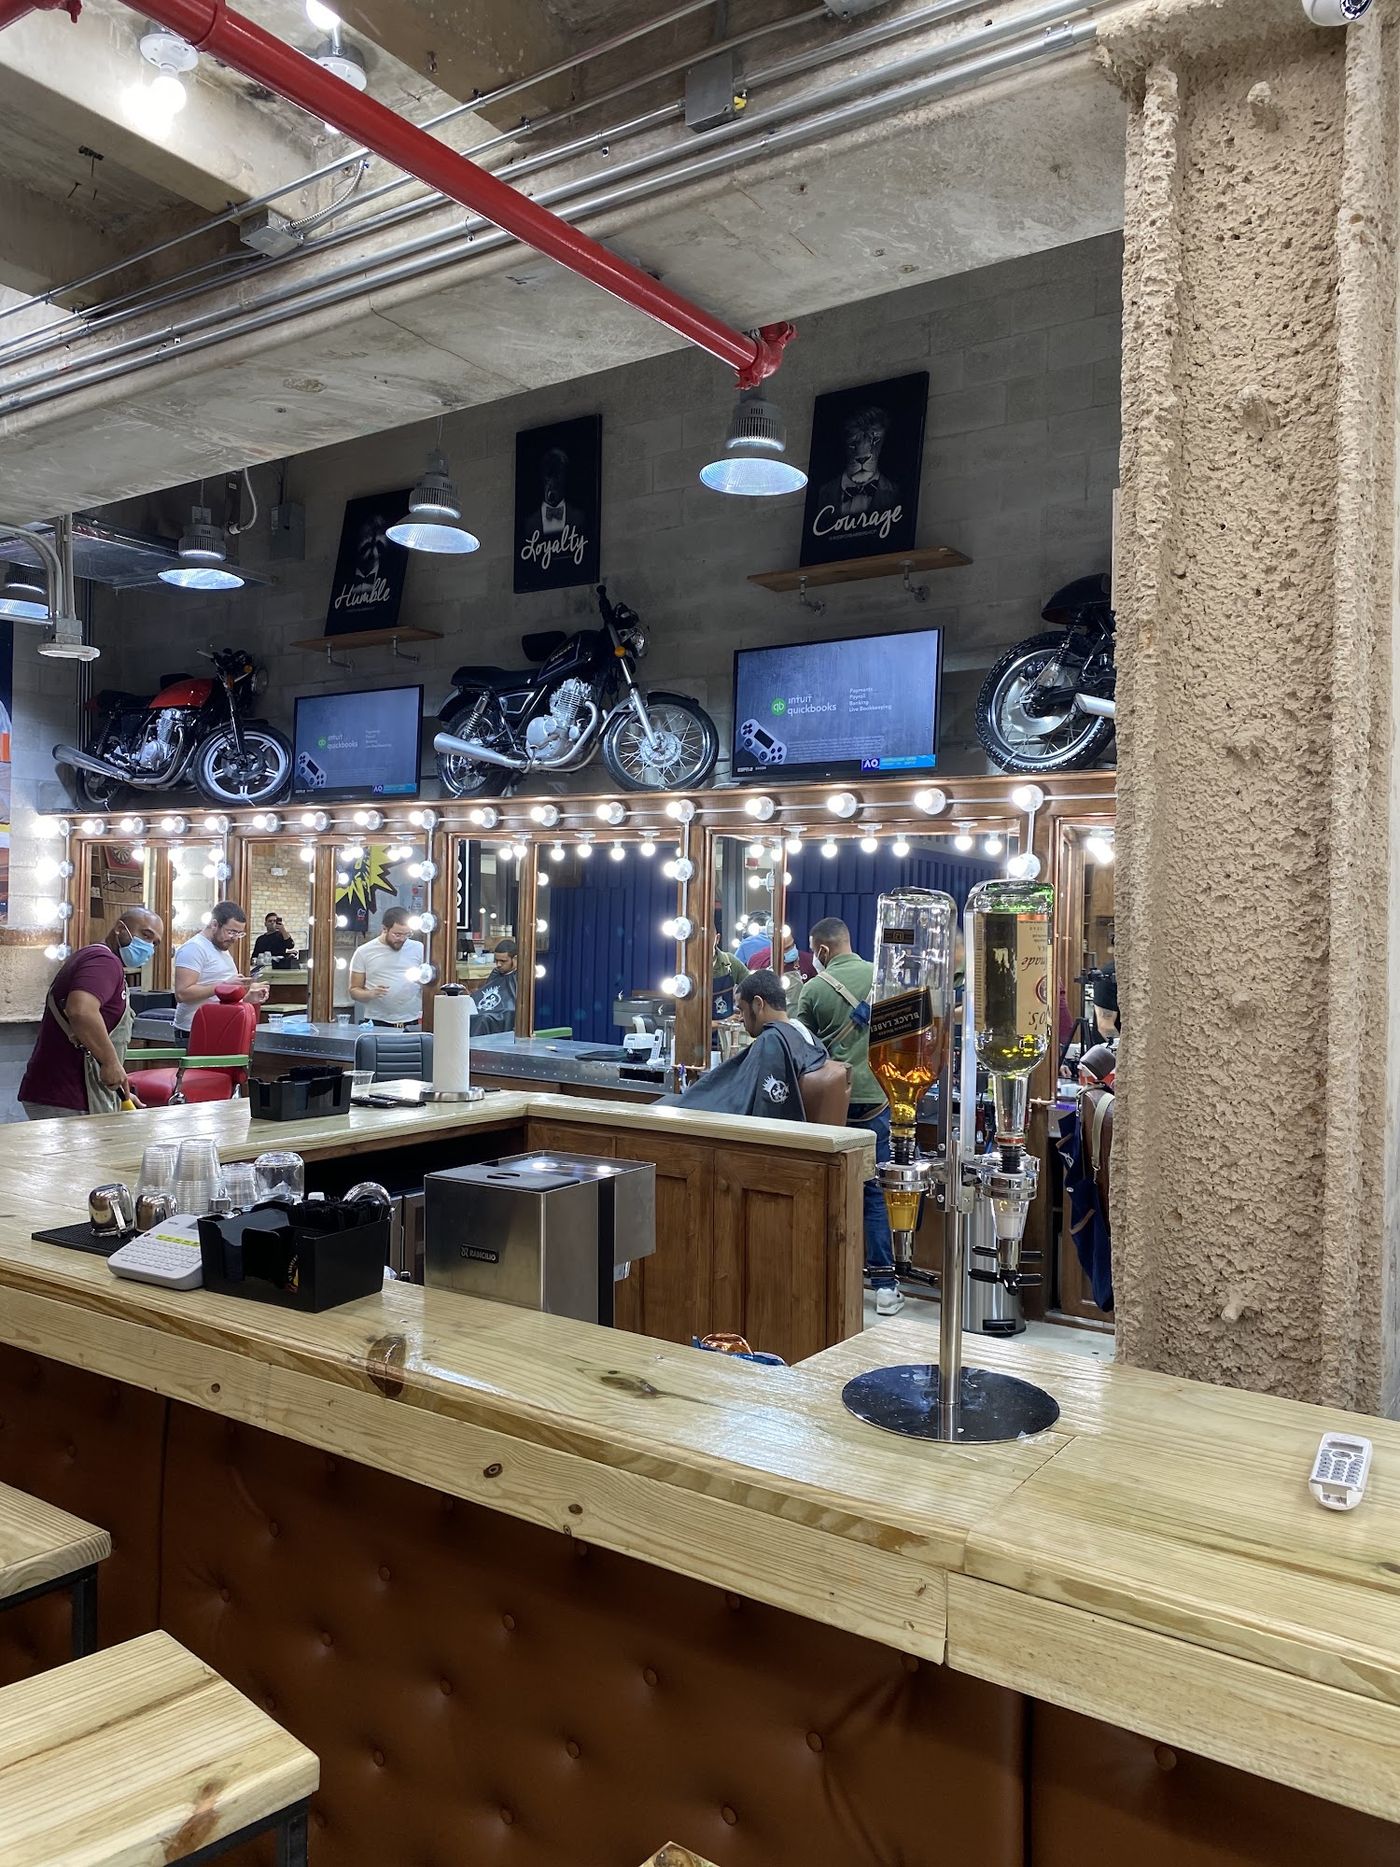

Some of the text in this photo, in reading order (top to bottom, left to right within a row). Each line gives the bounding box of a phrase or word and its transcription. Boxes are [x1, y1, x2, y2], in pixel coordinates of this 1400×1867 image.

[813, 504, 903, 539] Courage
[520, 524, 589, 570] Loyalty
[334, 577, 391, 609] Humble
[788, 693, 812, 705] intuit
[787, 702, 837, 717] quickbooks
[863, 758, 879, 769] AO
[893, 1011, 921, 1026] BLACK
